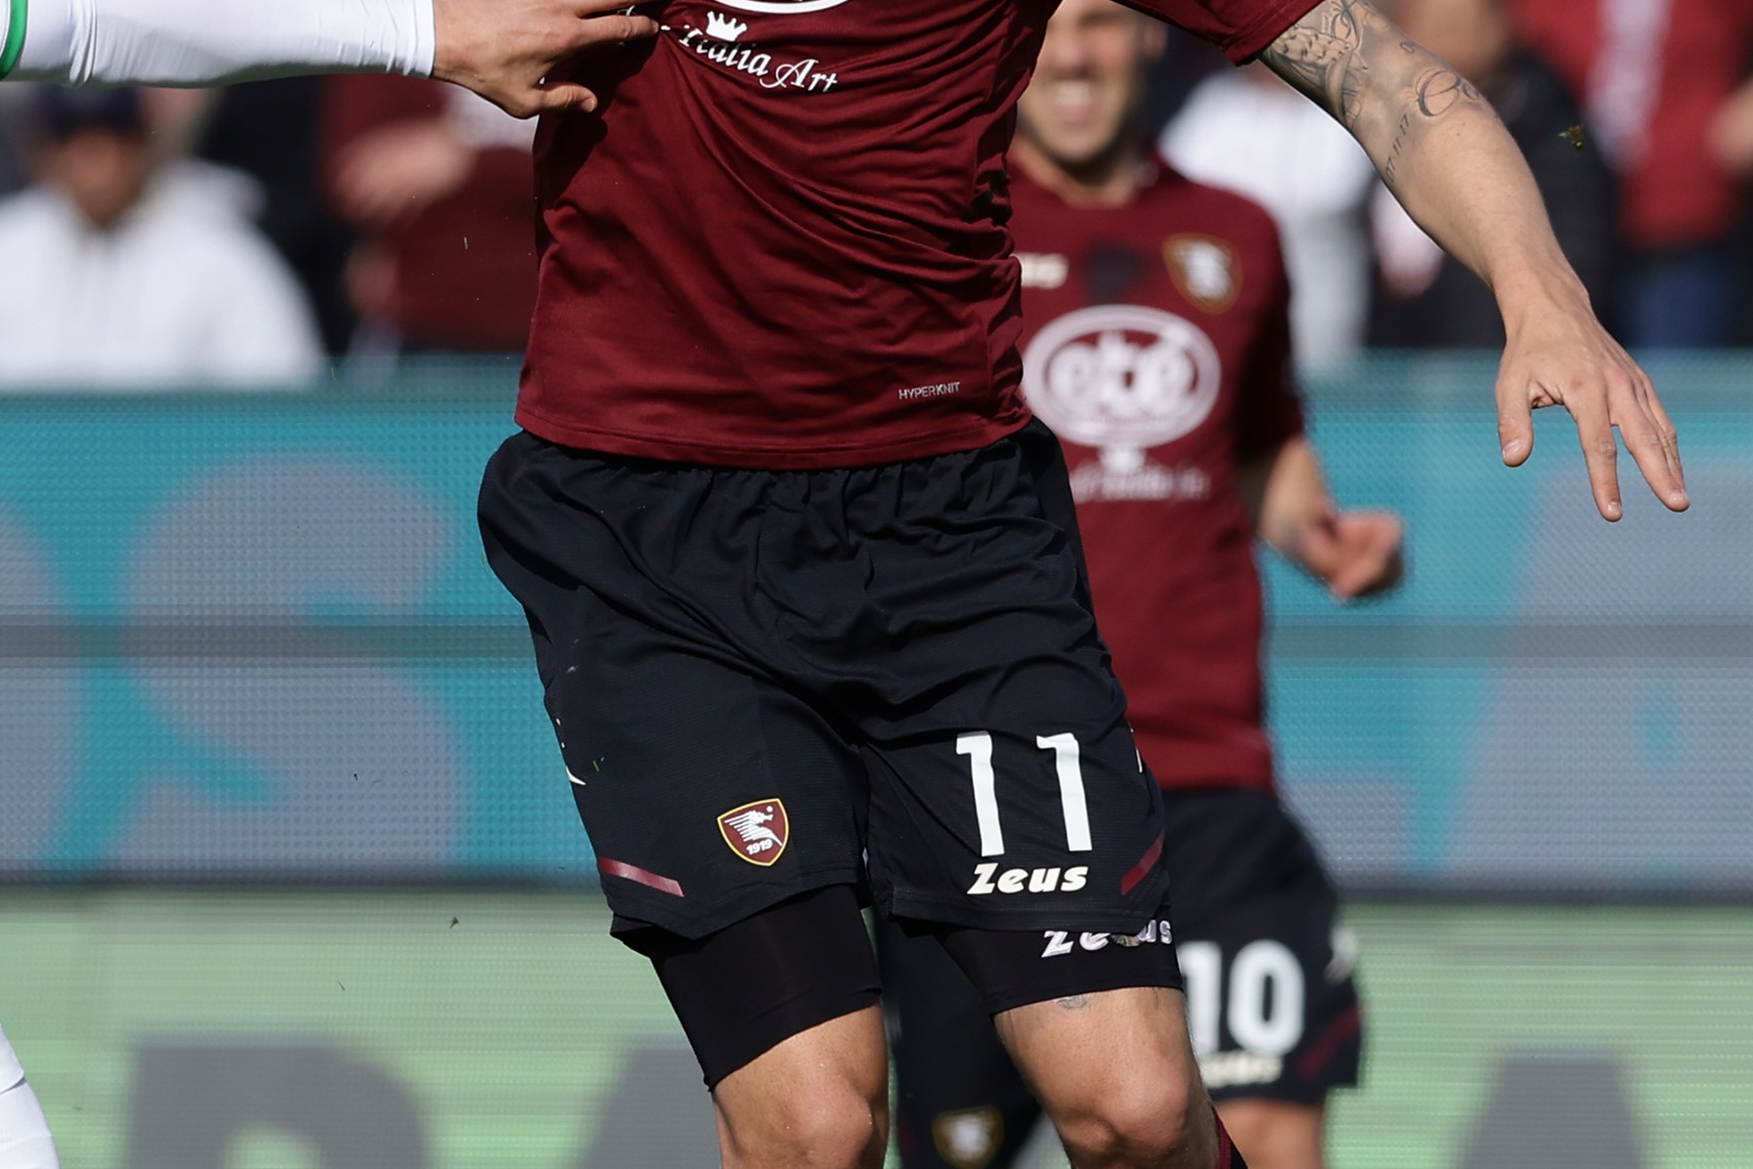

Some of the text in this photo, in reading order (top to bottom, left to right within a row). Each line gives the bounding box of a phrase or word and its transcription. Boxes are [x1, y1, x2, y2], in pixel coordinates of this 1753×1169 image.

[758, 57, 839, 93] Art
[898, 381, 961, 400] HYPERKNIT
[955, 730, 1093, 858] 11
[746, 838, 774, 856] 1919
[966, 862, 1089, 895] Zeus
[1176, 939, 1306, 1059] 10
